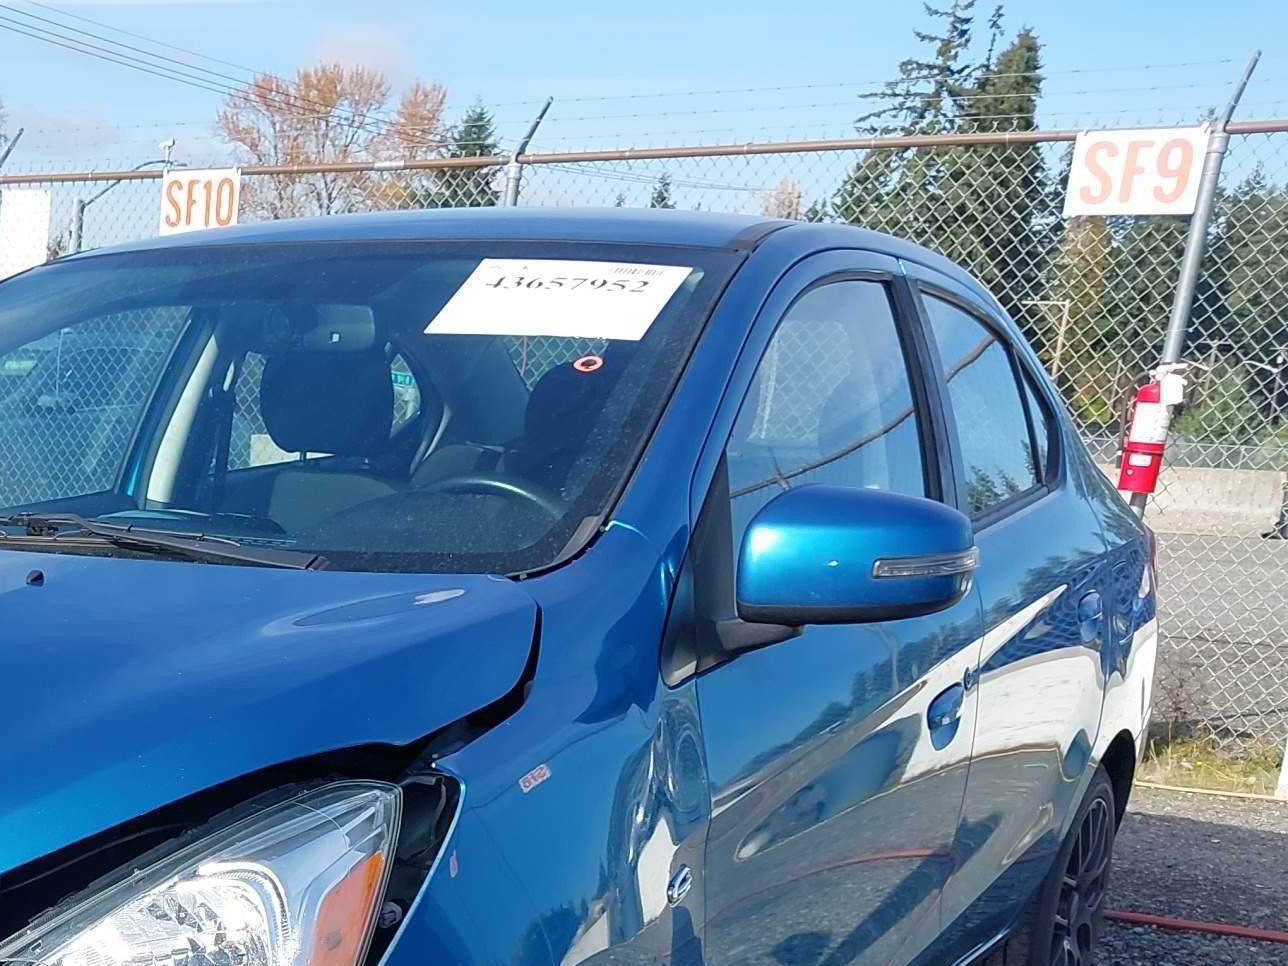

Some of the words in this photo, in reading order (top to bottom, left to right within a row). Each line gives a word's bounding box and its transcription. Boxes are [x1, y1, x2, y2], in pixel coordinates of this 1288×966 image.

[1080, 138, 1193, 204] SF9
[165, 177, 234, 228] SF10
[485, 276, 649, 292] 43657952
